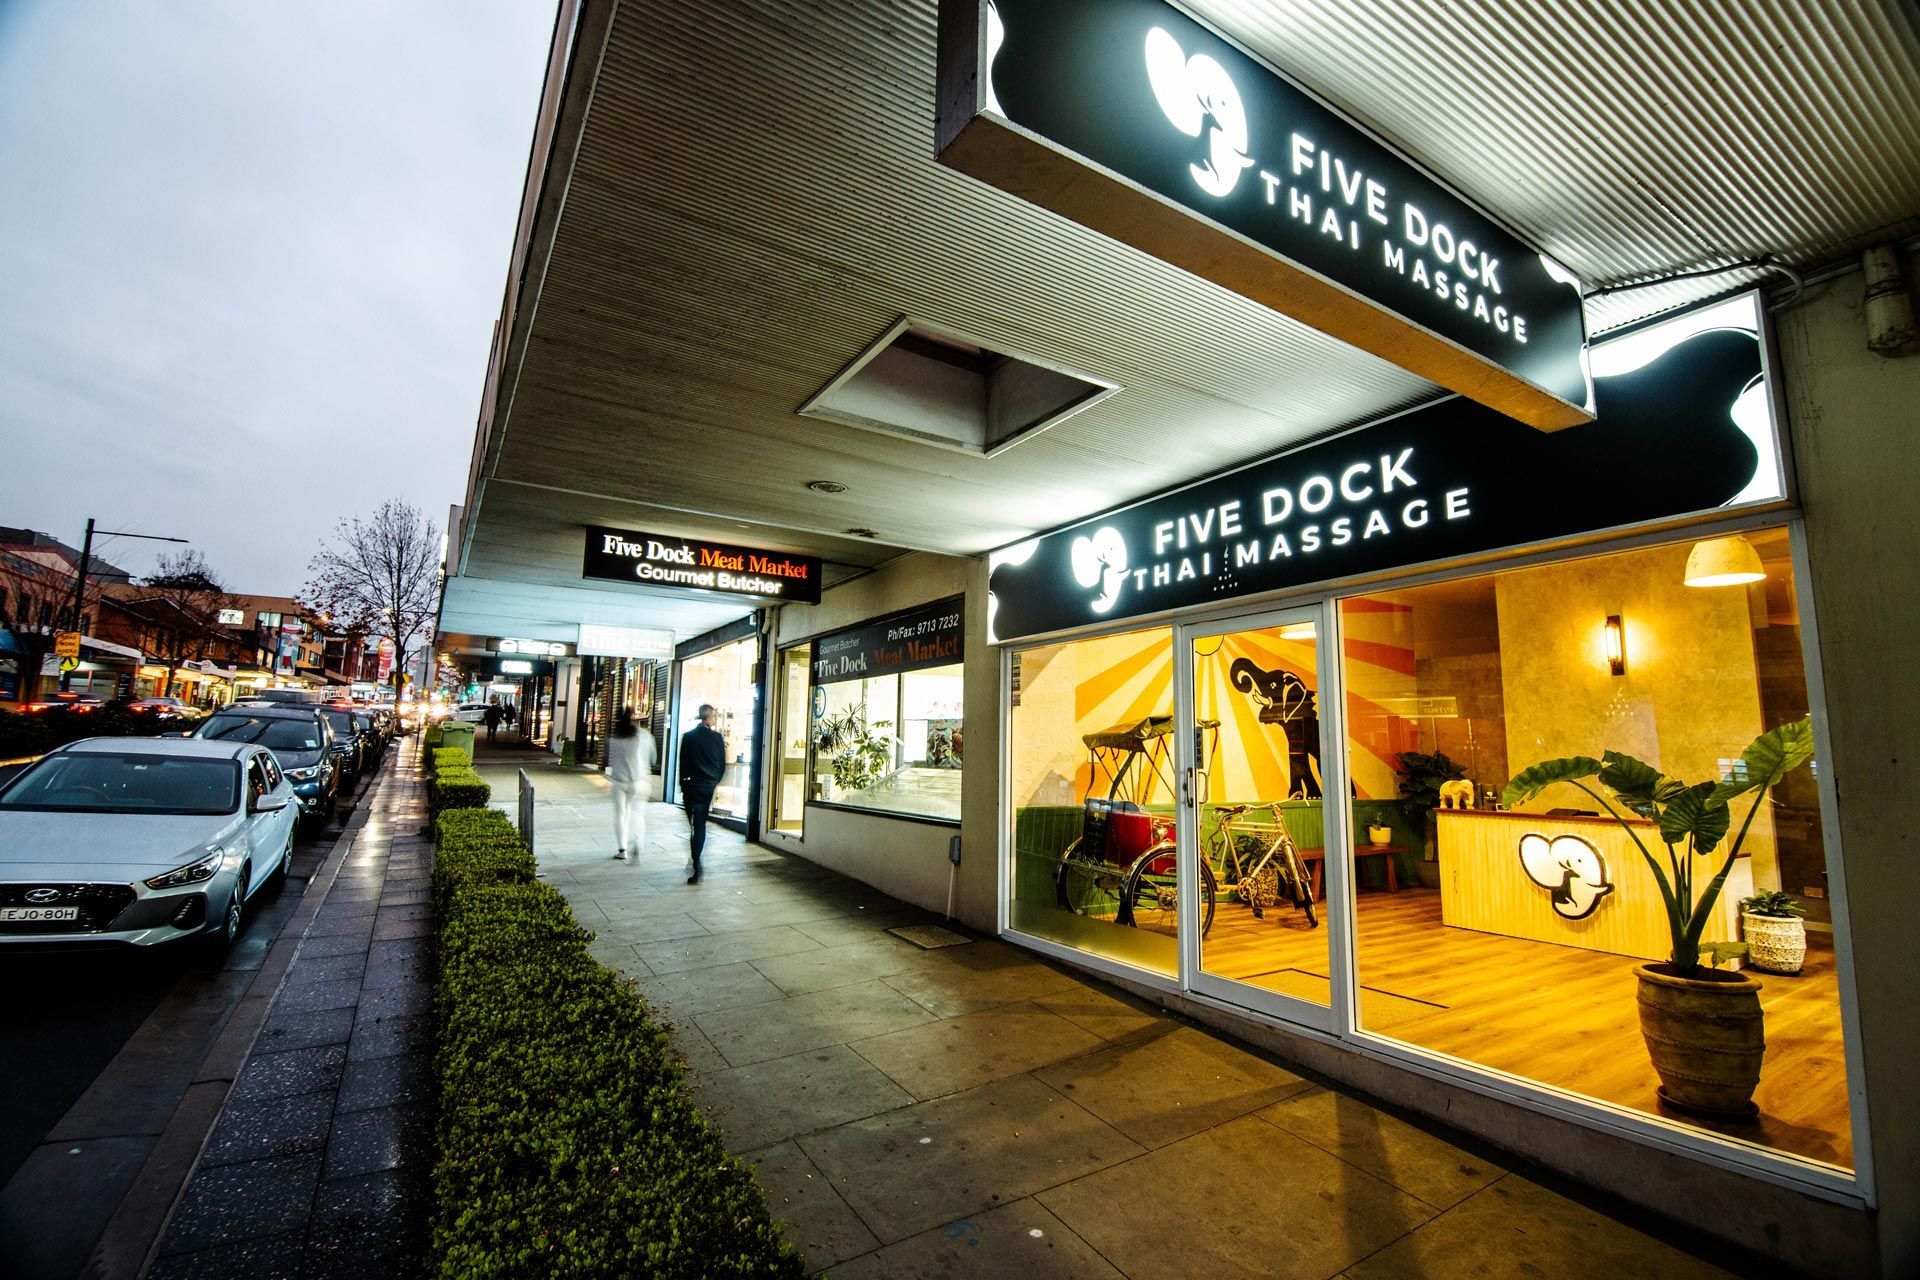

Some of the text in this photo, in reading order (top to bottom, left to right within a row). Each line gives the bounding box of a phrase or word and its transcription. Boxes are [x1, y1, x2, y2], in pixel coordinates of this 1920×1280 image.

[1292, 133, 1501, 294] FIVE DOCK
[1260, 170, 1527, 343] THAI MASSAGE
[1155, 447, 1417, 554] FIVE DOCK
[602, 534, 808, 579] Five Dock Meat Market
[1133, 487, 1471, 590] THAI MASSAGE
[636, 563, 782, 594] Gourmet Butcher
[820, 637, 860, 655] Gourmet Butcher
[887, 613, 959, 642] Ph/Fax: 9713 7232
[818, 659, 838, 678] Five
[840, 652, 868, 674] Dock
[873, 650, 905, 667] Meat
[907, 634, 960, 662] Market
